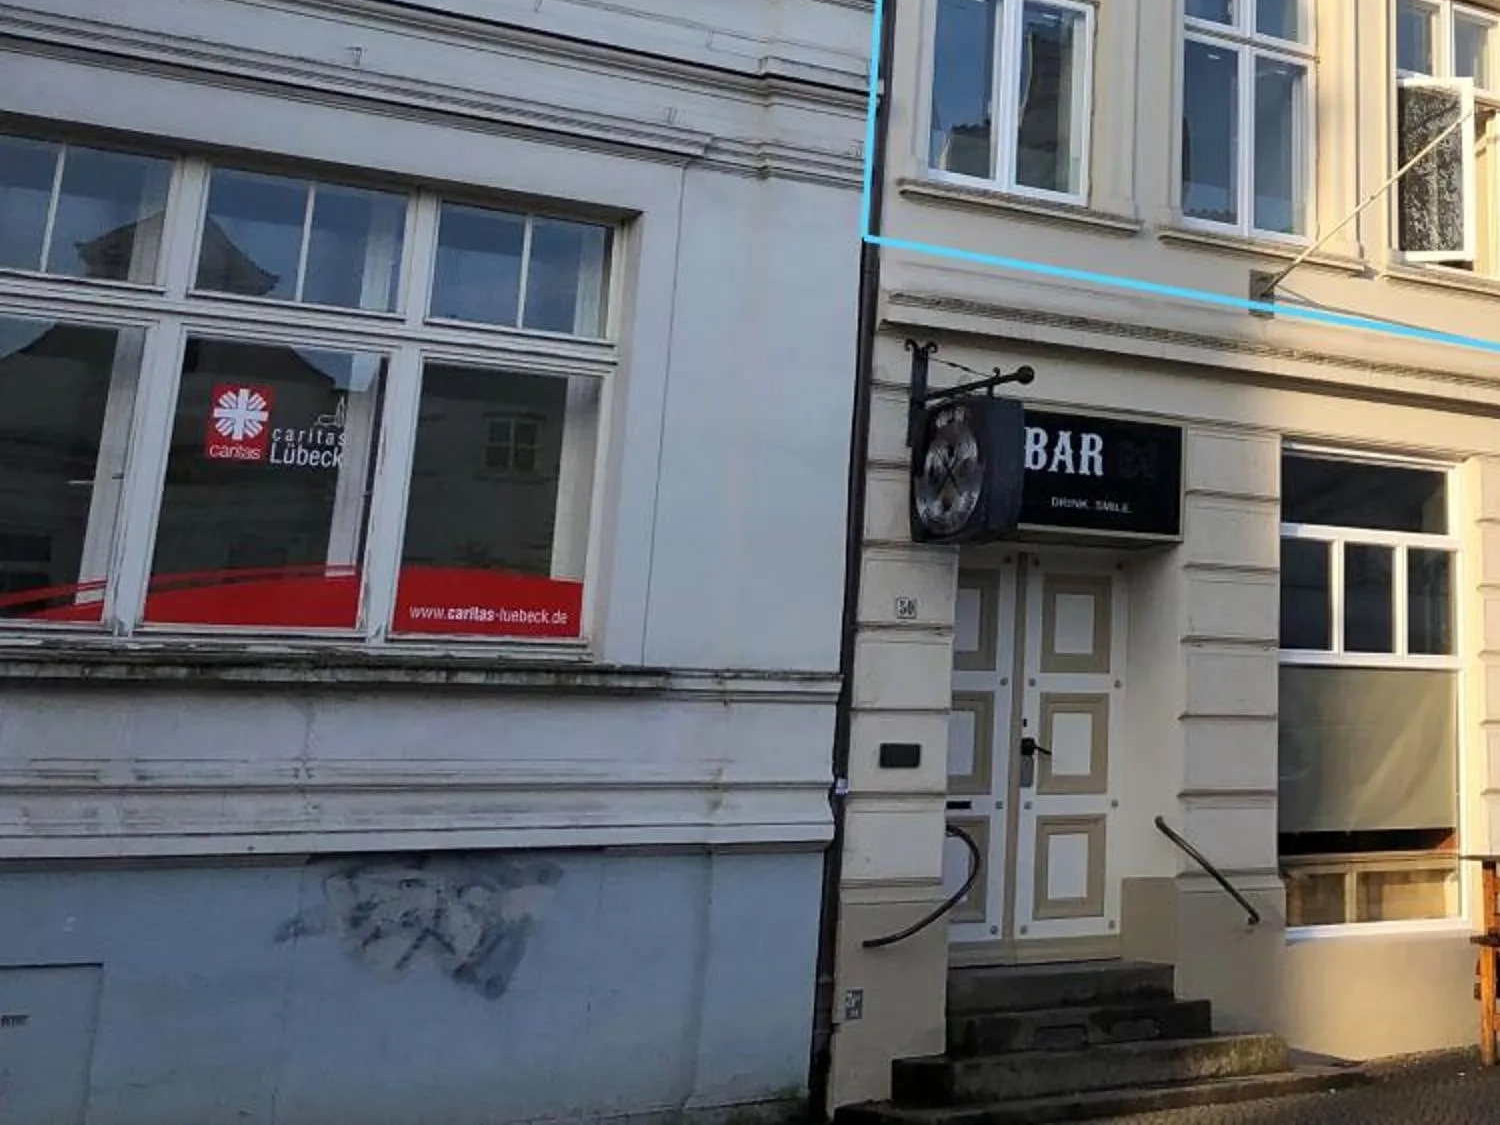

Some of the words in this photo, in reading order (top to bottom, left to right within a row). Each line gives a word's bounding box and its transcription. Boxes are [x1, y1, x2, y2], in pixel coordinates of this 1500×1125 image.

[272, 427, 346, 446] caritas
[209, 444, 261, 460] caritas
[269, 442, 344, 467] Lübeck
[1024, 426, 1104, 476] BAR
[408, 605, 569, 625] www.caritas-luebeck.de
